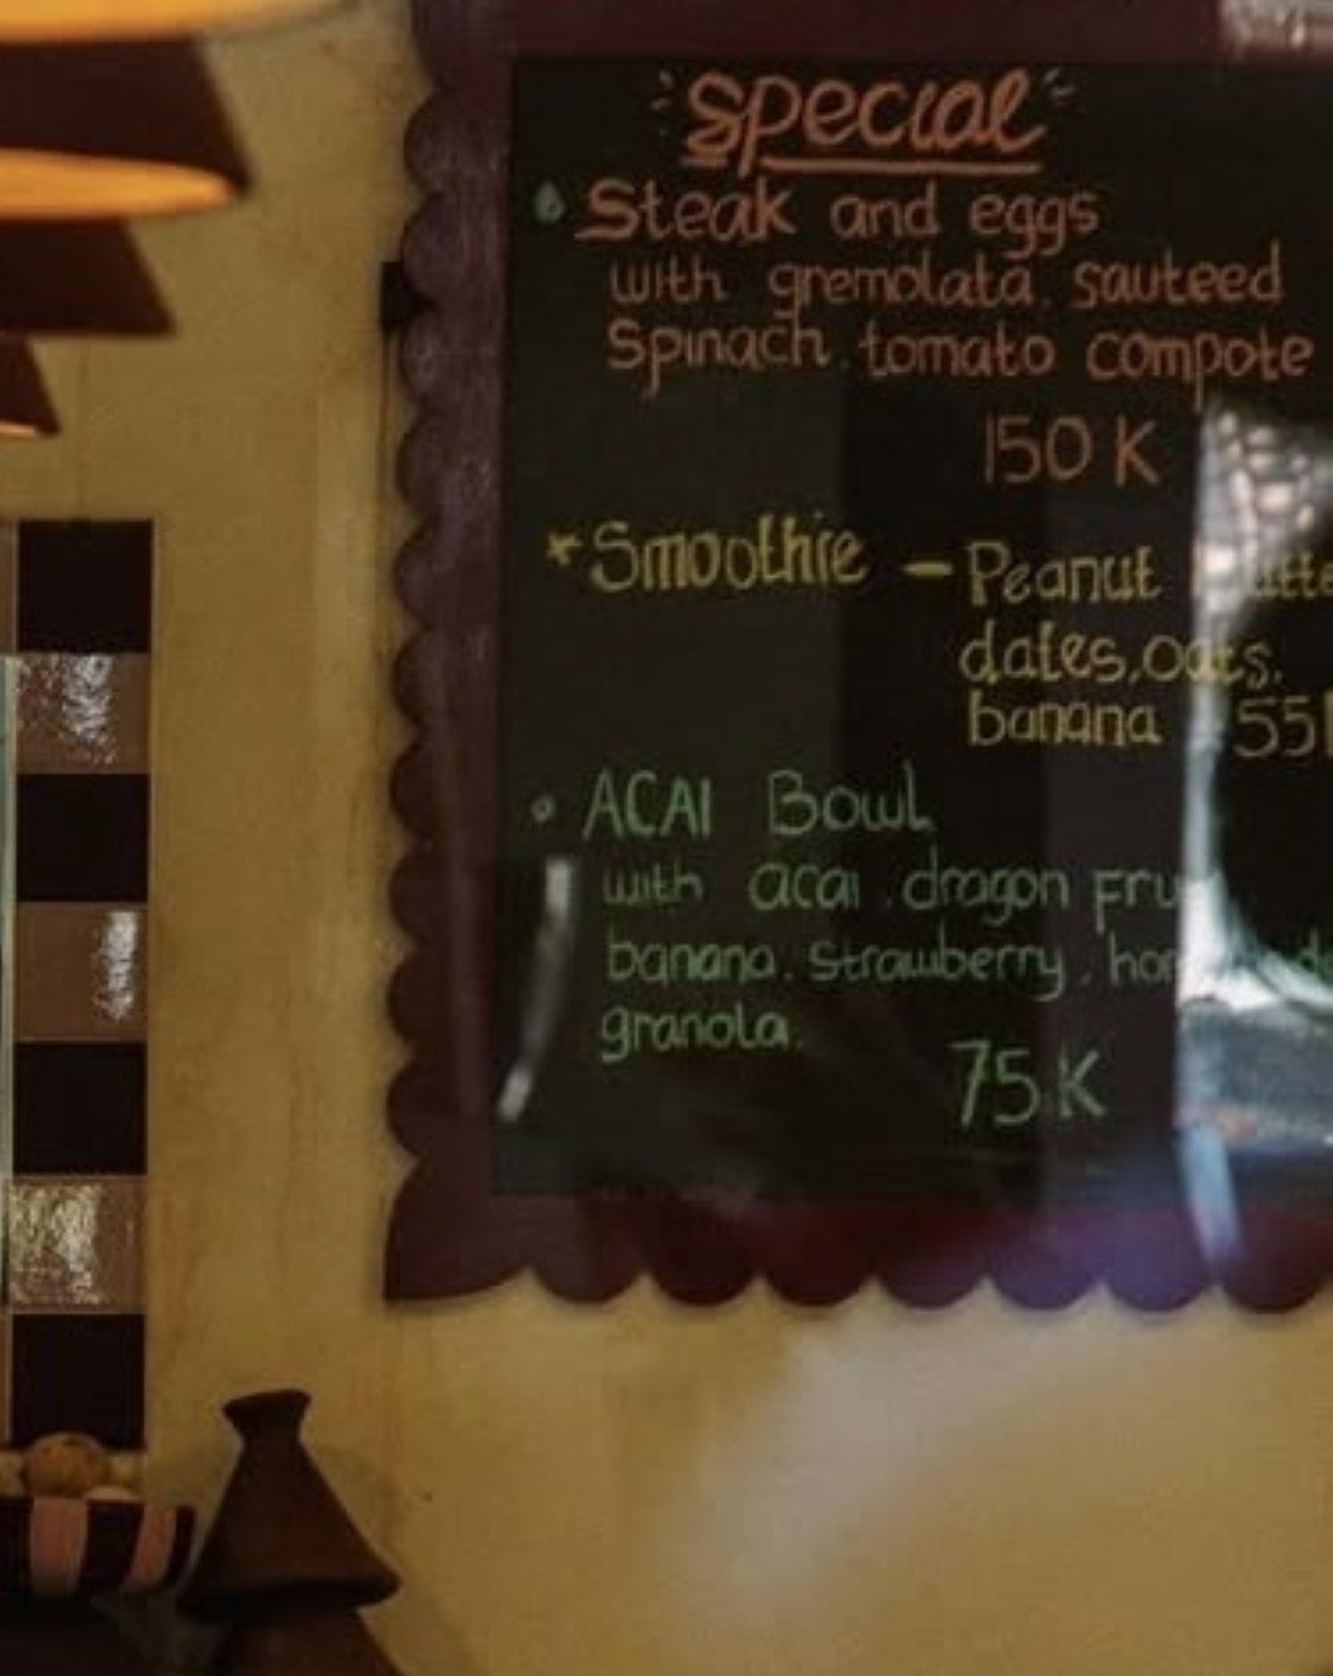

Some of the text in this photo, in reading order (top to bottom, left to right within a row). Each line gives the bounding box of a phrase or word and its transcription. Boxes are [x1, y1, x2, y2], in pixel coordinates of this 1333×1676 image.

[574, 175, 1101, 260] Steak and eggs
[609, 255, 727, 306] with
[1073, 241, 1284, 310] sauteed
[857, 320, 1057, 379] tomato
[1085, 328, 1317, 408] compote
[589, 512, 869, 592] Smoothie
[966, 540, 1164, 606] Peanut
[968, 688, 1164, 748] banana
[582, 763, 935, 839] ACAI Bowl
[602, 860, 704, 907] with
[902, 843, 1071, 928] dragon
